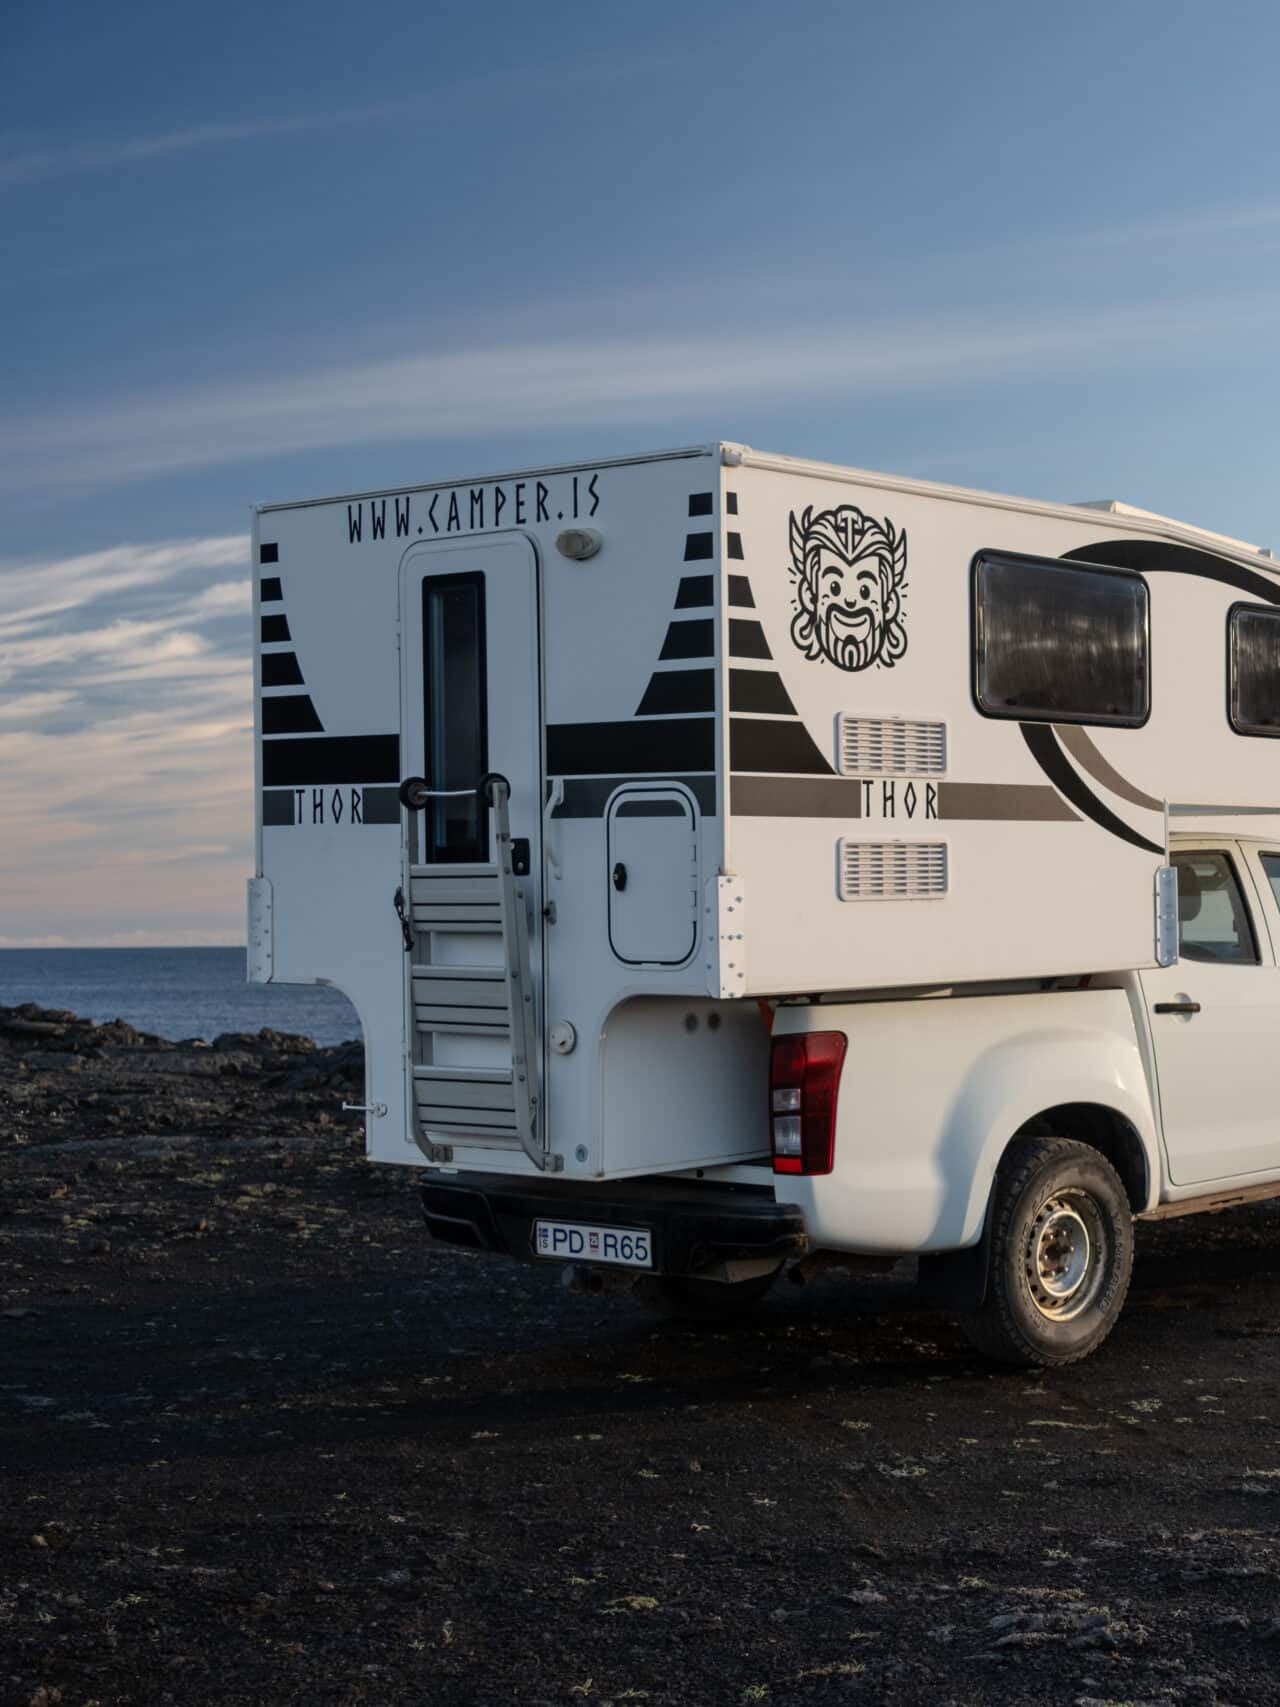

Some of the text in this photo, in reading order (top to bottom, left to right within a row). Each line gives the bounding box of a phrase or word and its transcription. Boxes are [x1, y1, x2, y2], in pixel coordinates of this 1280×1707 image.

[347, 474, 600, 543] WWW.CAMPER.IS
[295, 788, 362, 825] THOR
[862, 780, 937, 819] THOR
[553, 1228, 584, 1254] PD
[603, 1233, 648, 1261] R65
